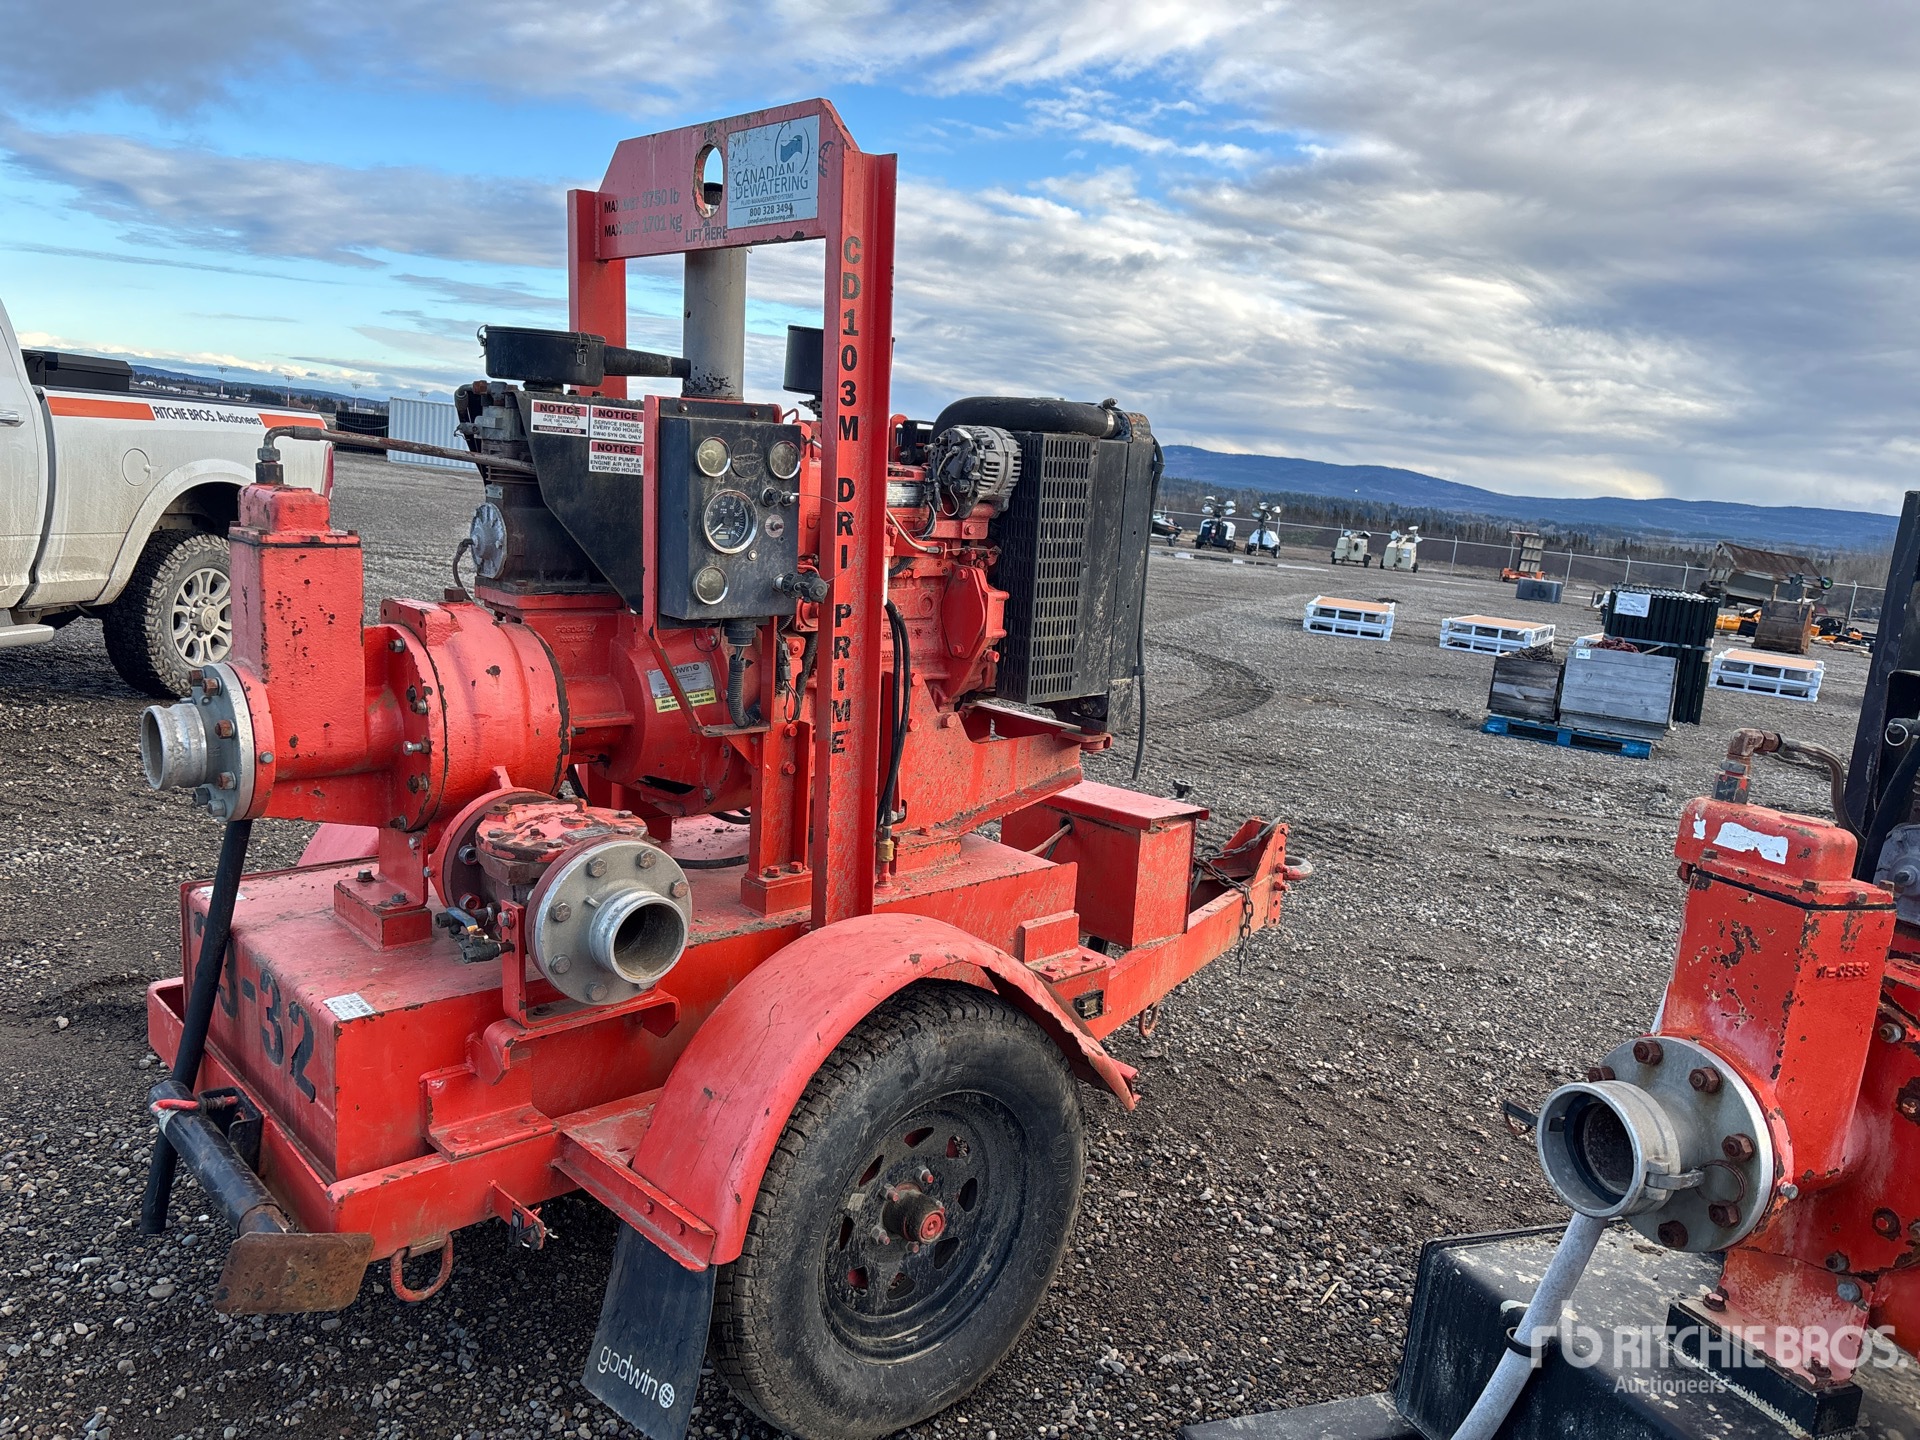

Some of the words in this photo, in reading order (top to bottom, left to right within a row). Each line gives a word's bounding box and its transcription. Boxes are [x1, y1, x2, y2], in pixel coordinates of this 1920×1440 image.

[736, 162, 795, 187] CANADIAN
[735, 175, 809, 200] DEWATERING
[749, 208, 762, 217] 800
[763, 205, 775, 215] 328
[642, 215, 667, 234] 1701
[670, 213, 683, 233] kg
[686, 228, 704, 243] LIFT
[704, 225, 728, 241] HERE
[153, 406, 190, 421] RITCHIE
[188, 408, 218, 422] BROS.
[216, 411, 263, 426] Auctioneers
[540, 403, 581, 415] NOTICE
[598, 409, 638, 421] NOTICE
[594, 419, 618, 427] SERVICE
[597, 443, 637, 454] NOTICE
[597, 1345, 659, 1401] godwin
